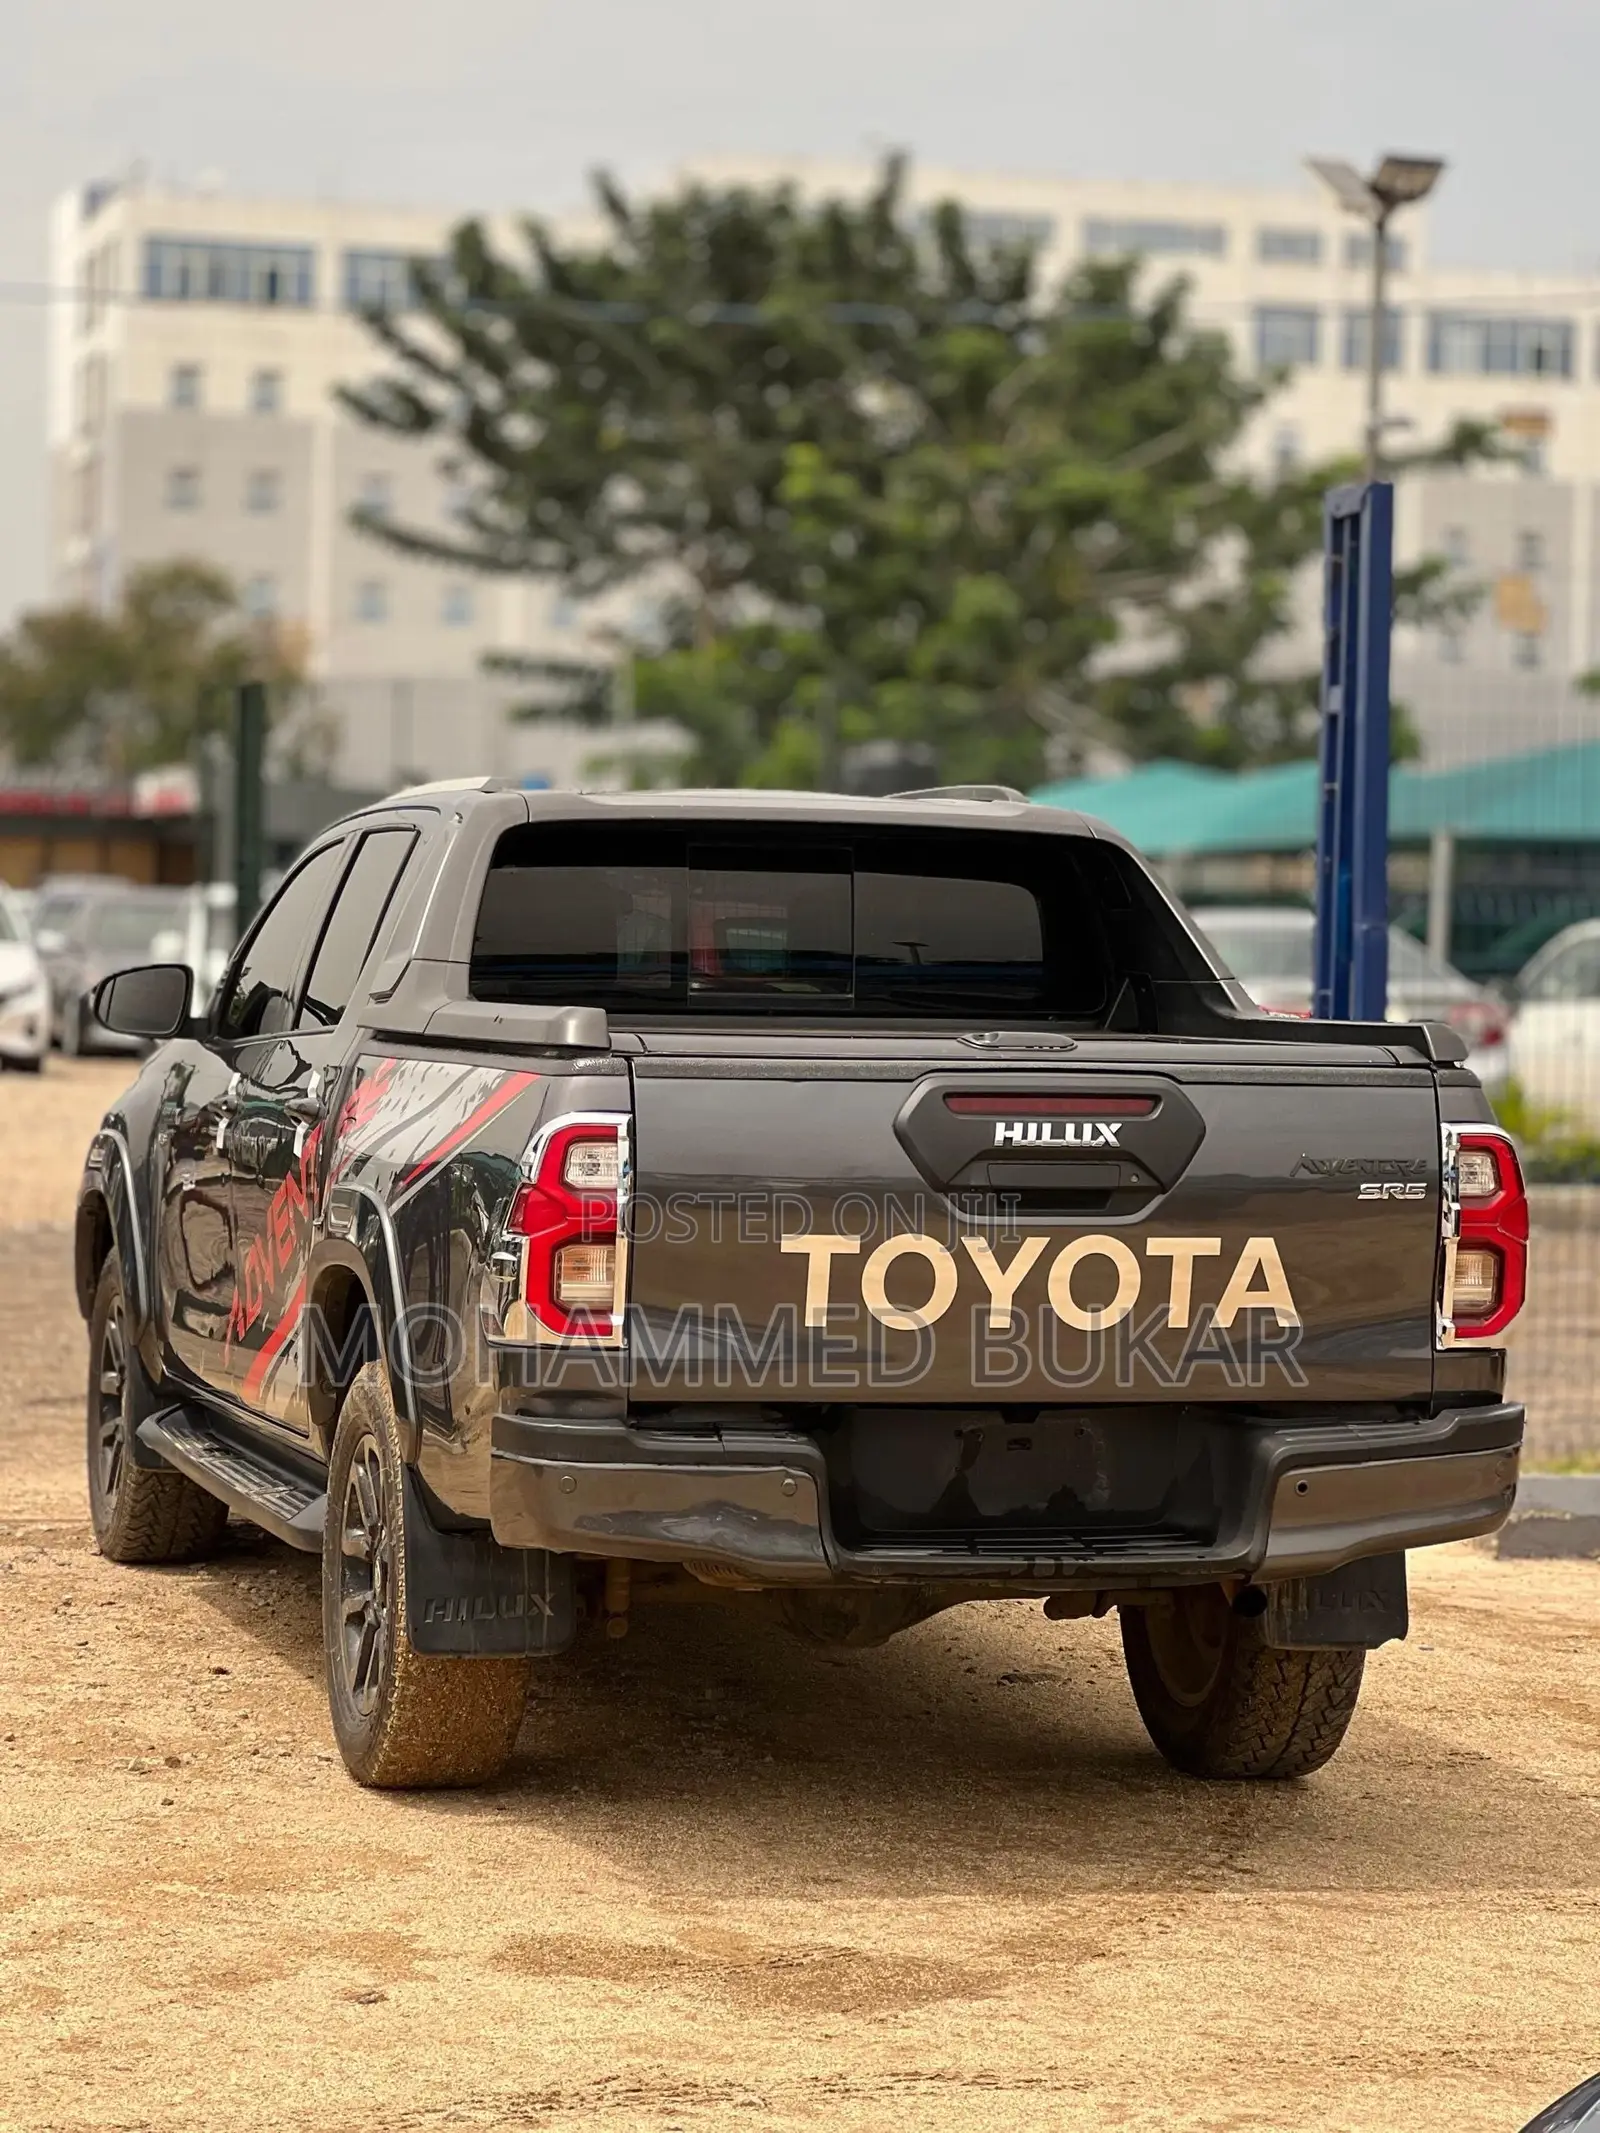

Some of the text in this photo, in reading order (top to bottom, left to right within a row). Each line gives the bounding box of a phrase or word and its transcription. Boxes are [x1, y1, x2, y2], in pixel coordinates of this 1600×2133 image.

[994, 1122, 1122, 1146] HILUX
[1357, 1183, 1427, 1200] SR5
[780, 1233, 1301, 1331] TOYOTA
[424, 1592, 556, 1623] HILUX
